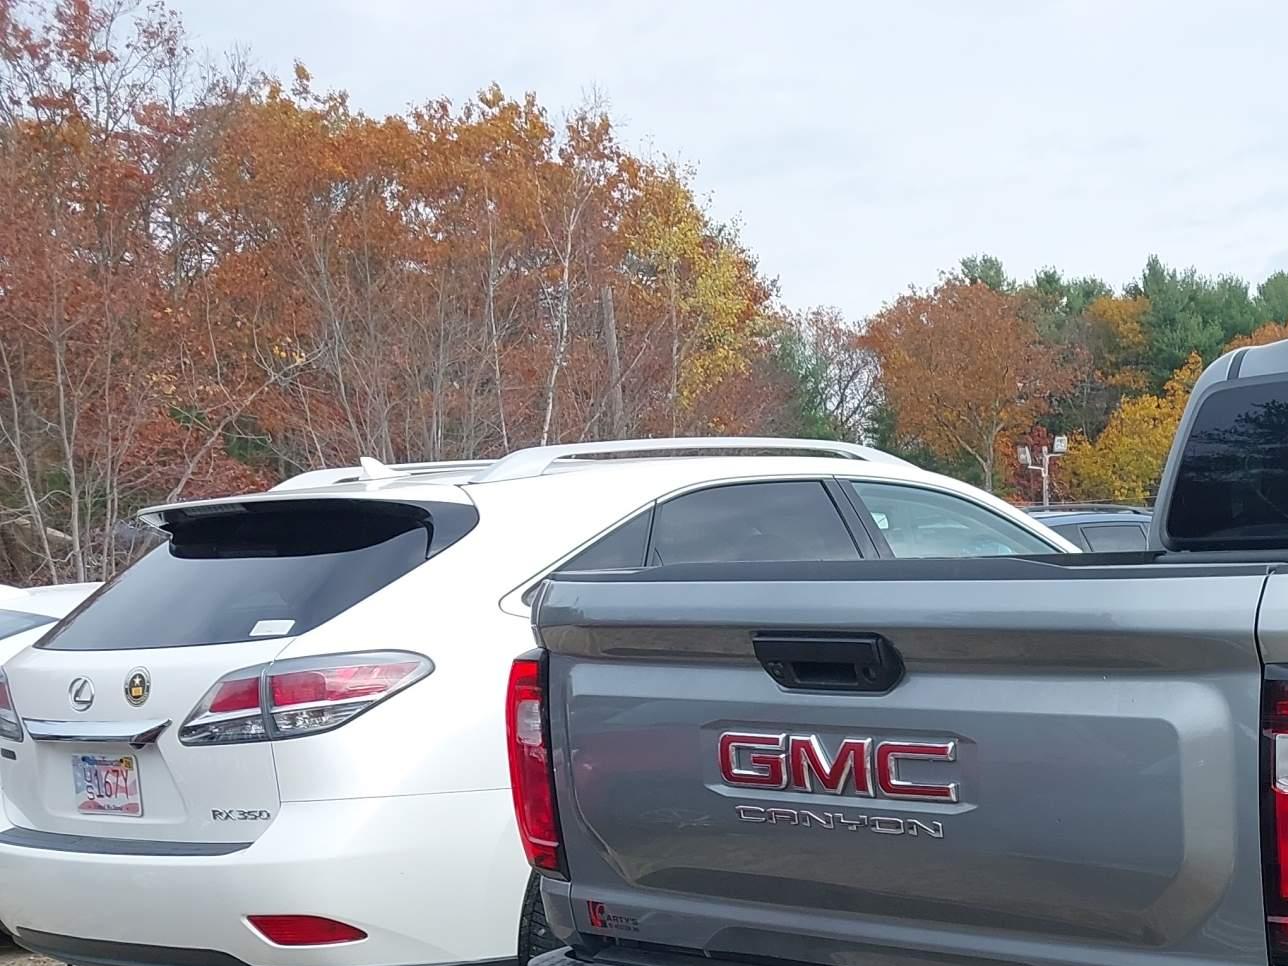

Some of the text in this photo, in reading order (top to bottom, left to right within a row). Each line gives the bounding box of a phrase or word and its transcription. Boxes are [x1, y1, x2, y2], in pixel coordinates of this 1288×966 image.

[718, 731, 959, 802] GMC
[95, 768, 129, 800] 167Y
[211, 809, 272, 821] RX 350
[735, 805, 944, 839] CANYON
